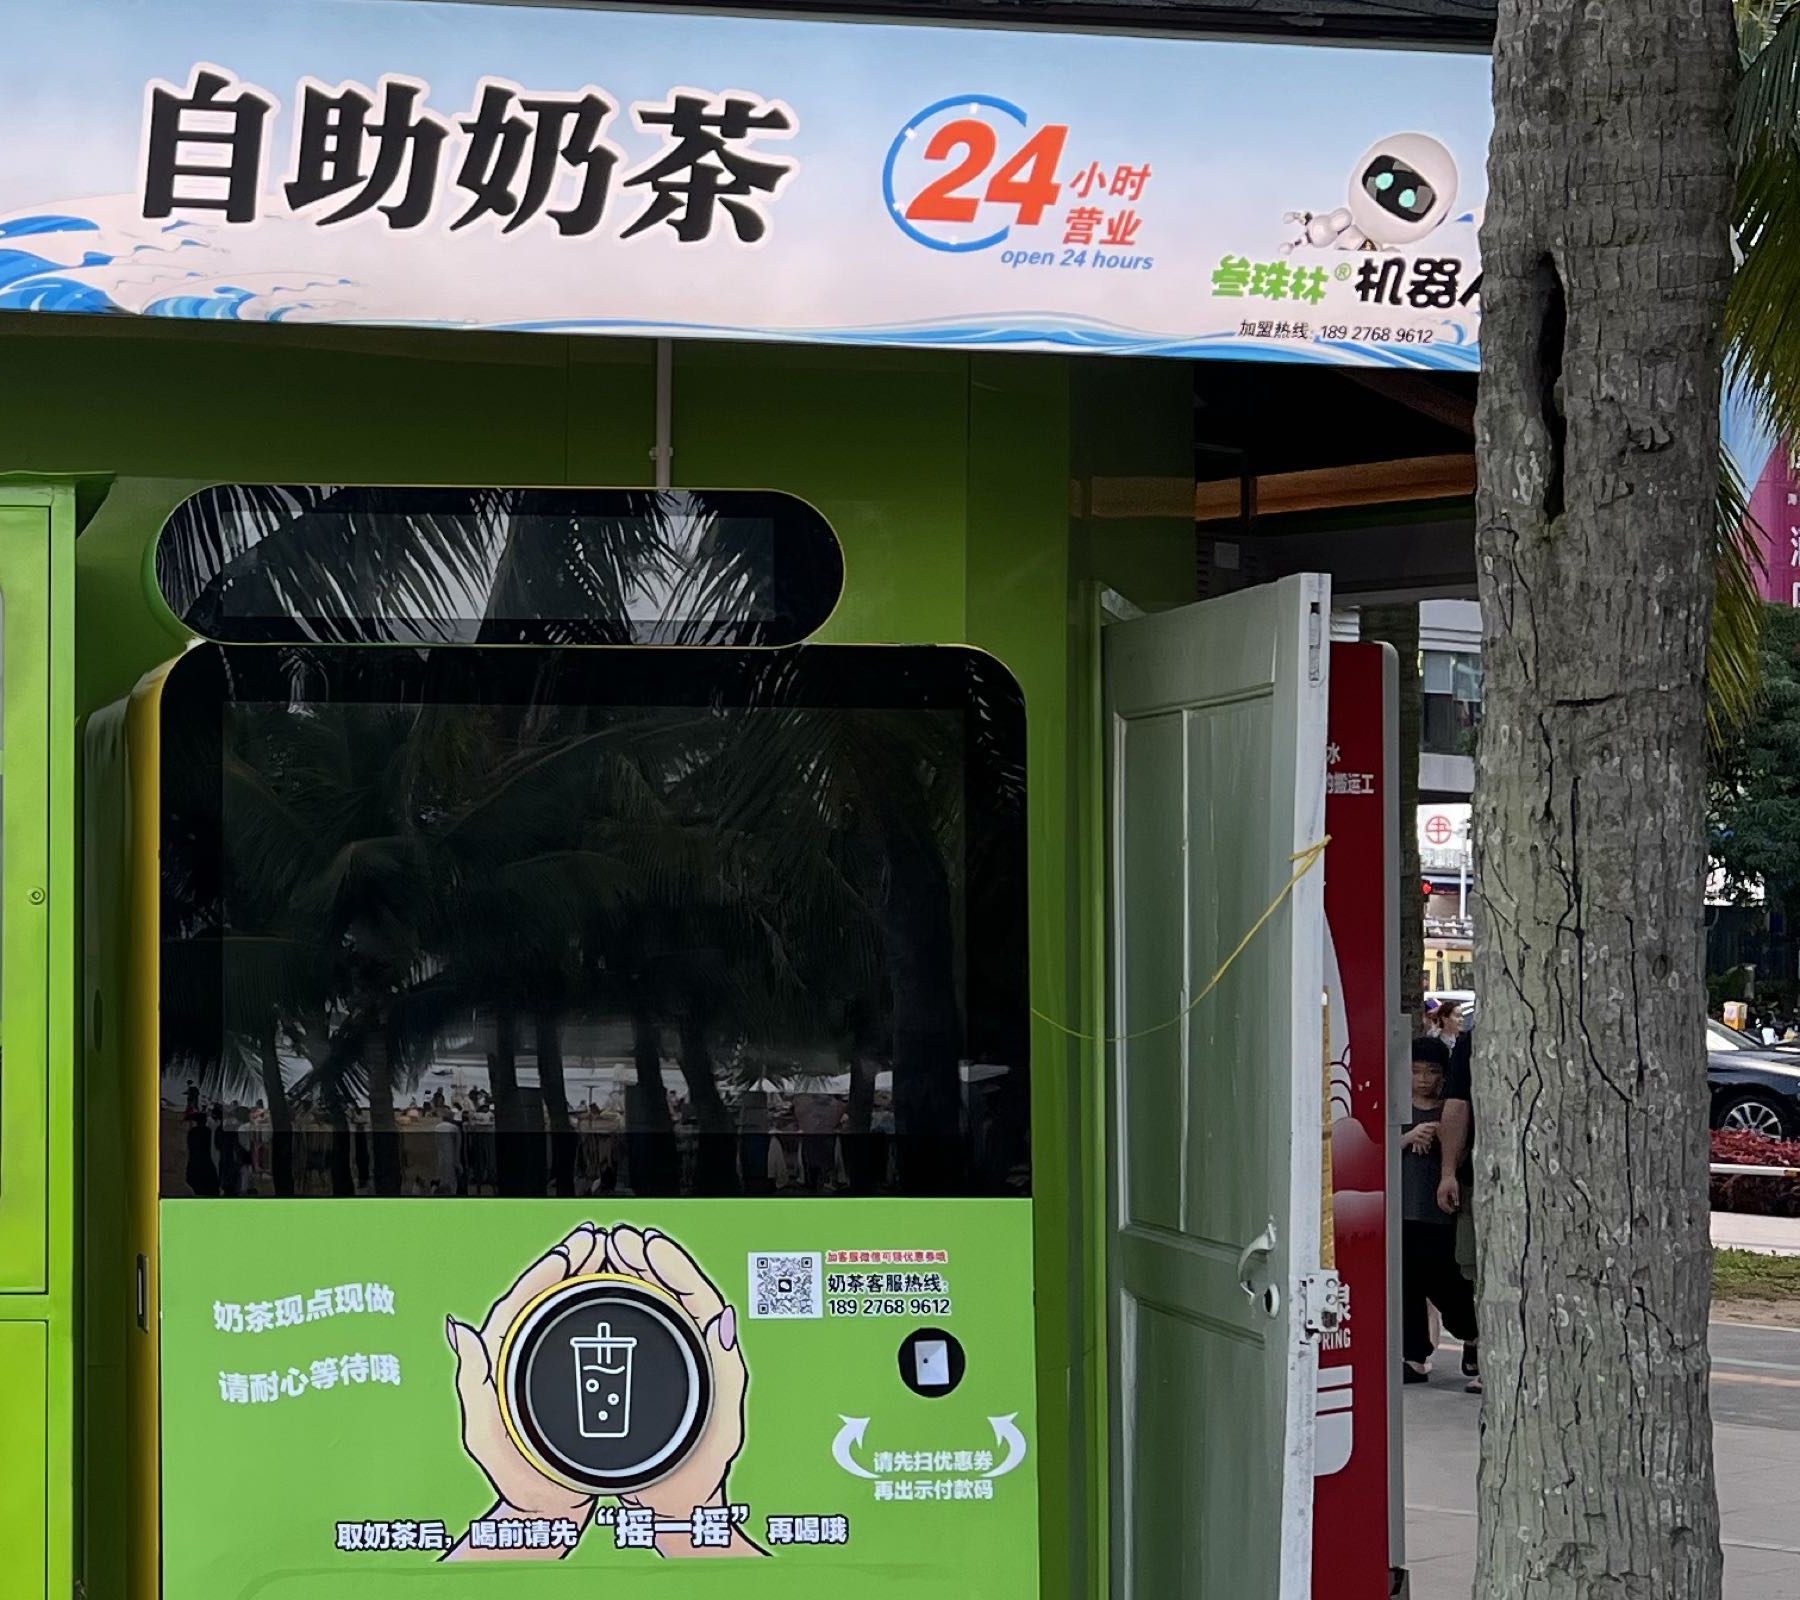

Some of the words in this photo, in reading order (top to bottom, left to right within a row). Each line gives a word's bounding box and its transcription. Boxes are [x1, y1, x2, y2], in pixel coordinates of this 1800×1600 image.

[142, 71, 791, 243] 自助奶茶
[904, 118, 1069, 225] 24
[1069, 161, 1152, 201] 小时
[1062, 206, 1143, 246] 营业
[1001, 250, 1055, 267] open
[1060, 250, 1086, 268] 24
[1092, 250, 1154, 270] hours
[1320, 325, 1348, 339] 189
[1352, 326, 1392, 342] 2768
[1394, 328, 1434, 344] 9612
[212, 1281, 396, 1334] 奶茶现点现做
[828, 1299, 857, 1315] 189
[862, 1299, 904, 1315] 2768
[910, 1299, 950, 1315] 9612
[217, 1352, 401, 1405] 请耐心等待哦
[873, 1450, 994, 1473] 请先扫优惠券
[873, 1479, 994, 1501] 再出示付款码
[336, 1520, 454, 1551] 取奶茶后，
[469, 1519, 579, 1549] 喝前请先
[766, 1515, 849, 1545] 再喝哦
